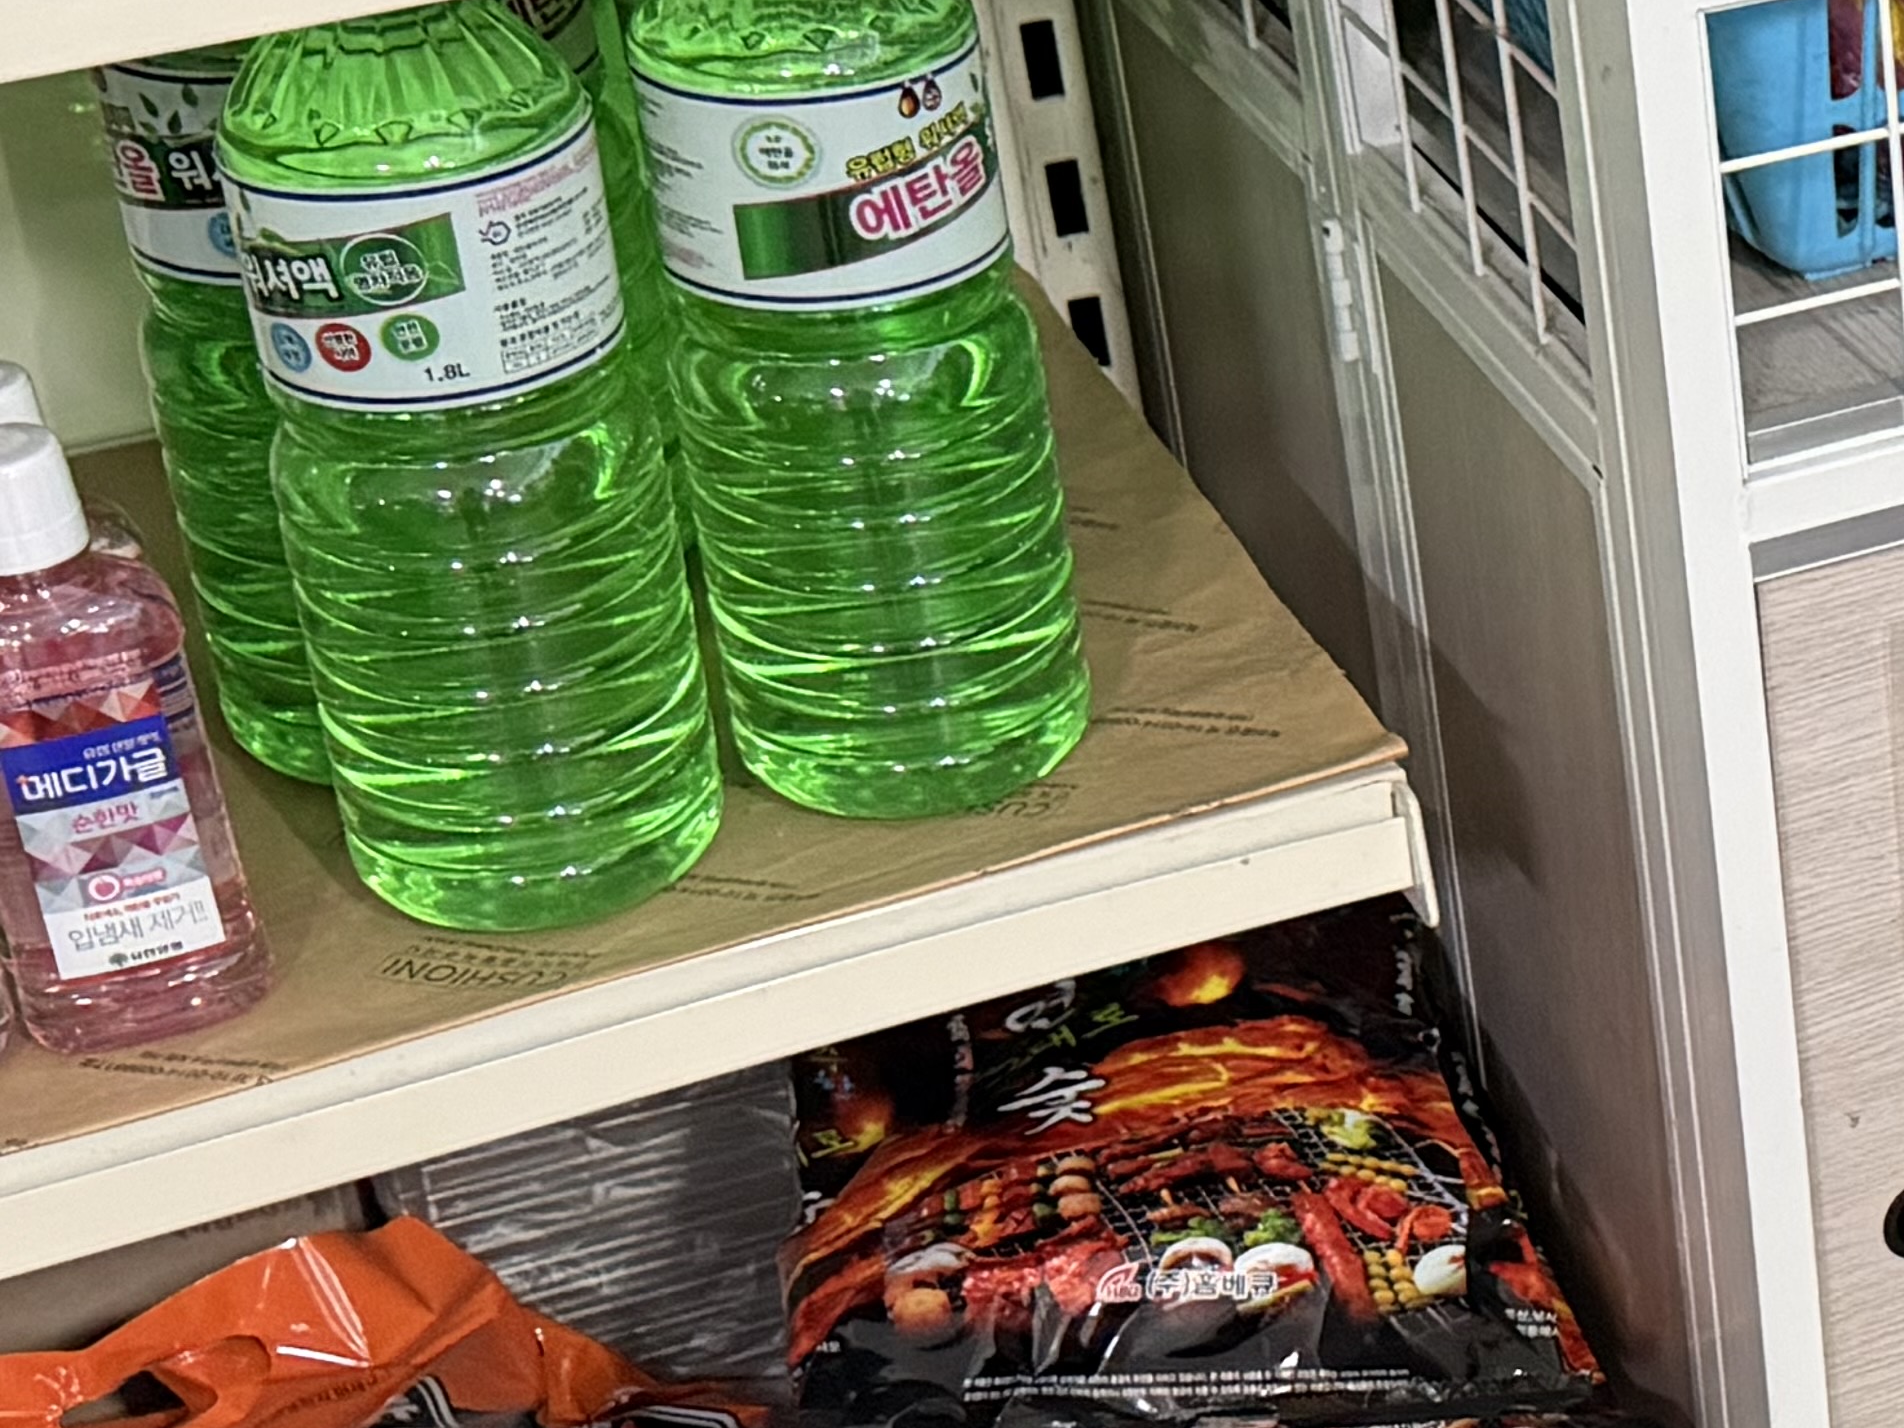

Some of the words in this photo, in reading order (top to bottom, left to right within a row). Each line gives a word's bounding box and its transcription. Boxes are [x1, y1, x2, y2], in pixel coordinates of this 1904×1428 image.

[855, 140, 983, 236] 에탄올
[423, 363, 471, 383] 1.8L
[21, 747, 169, 802] 메디가글
[72, 801, 140, 835] 순한맛
[68, 915, 144, 953] 입냄새
[1144, 1270, 1279, 1302] (주)홈베큐
